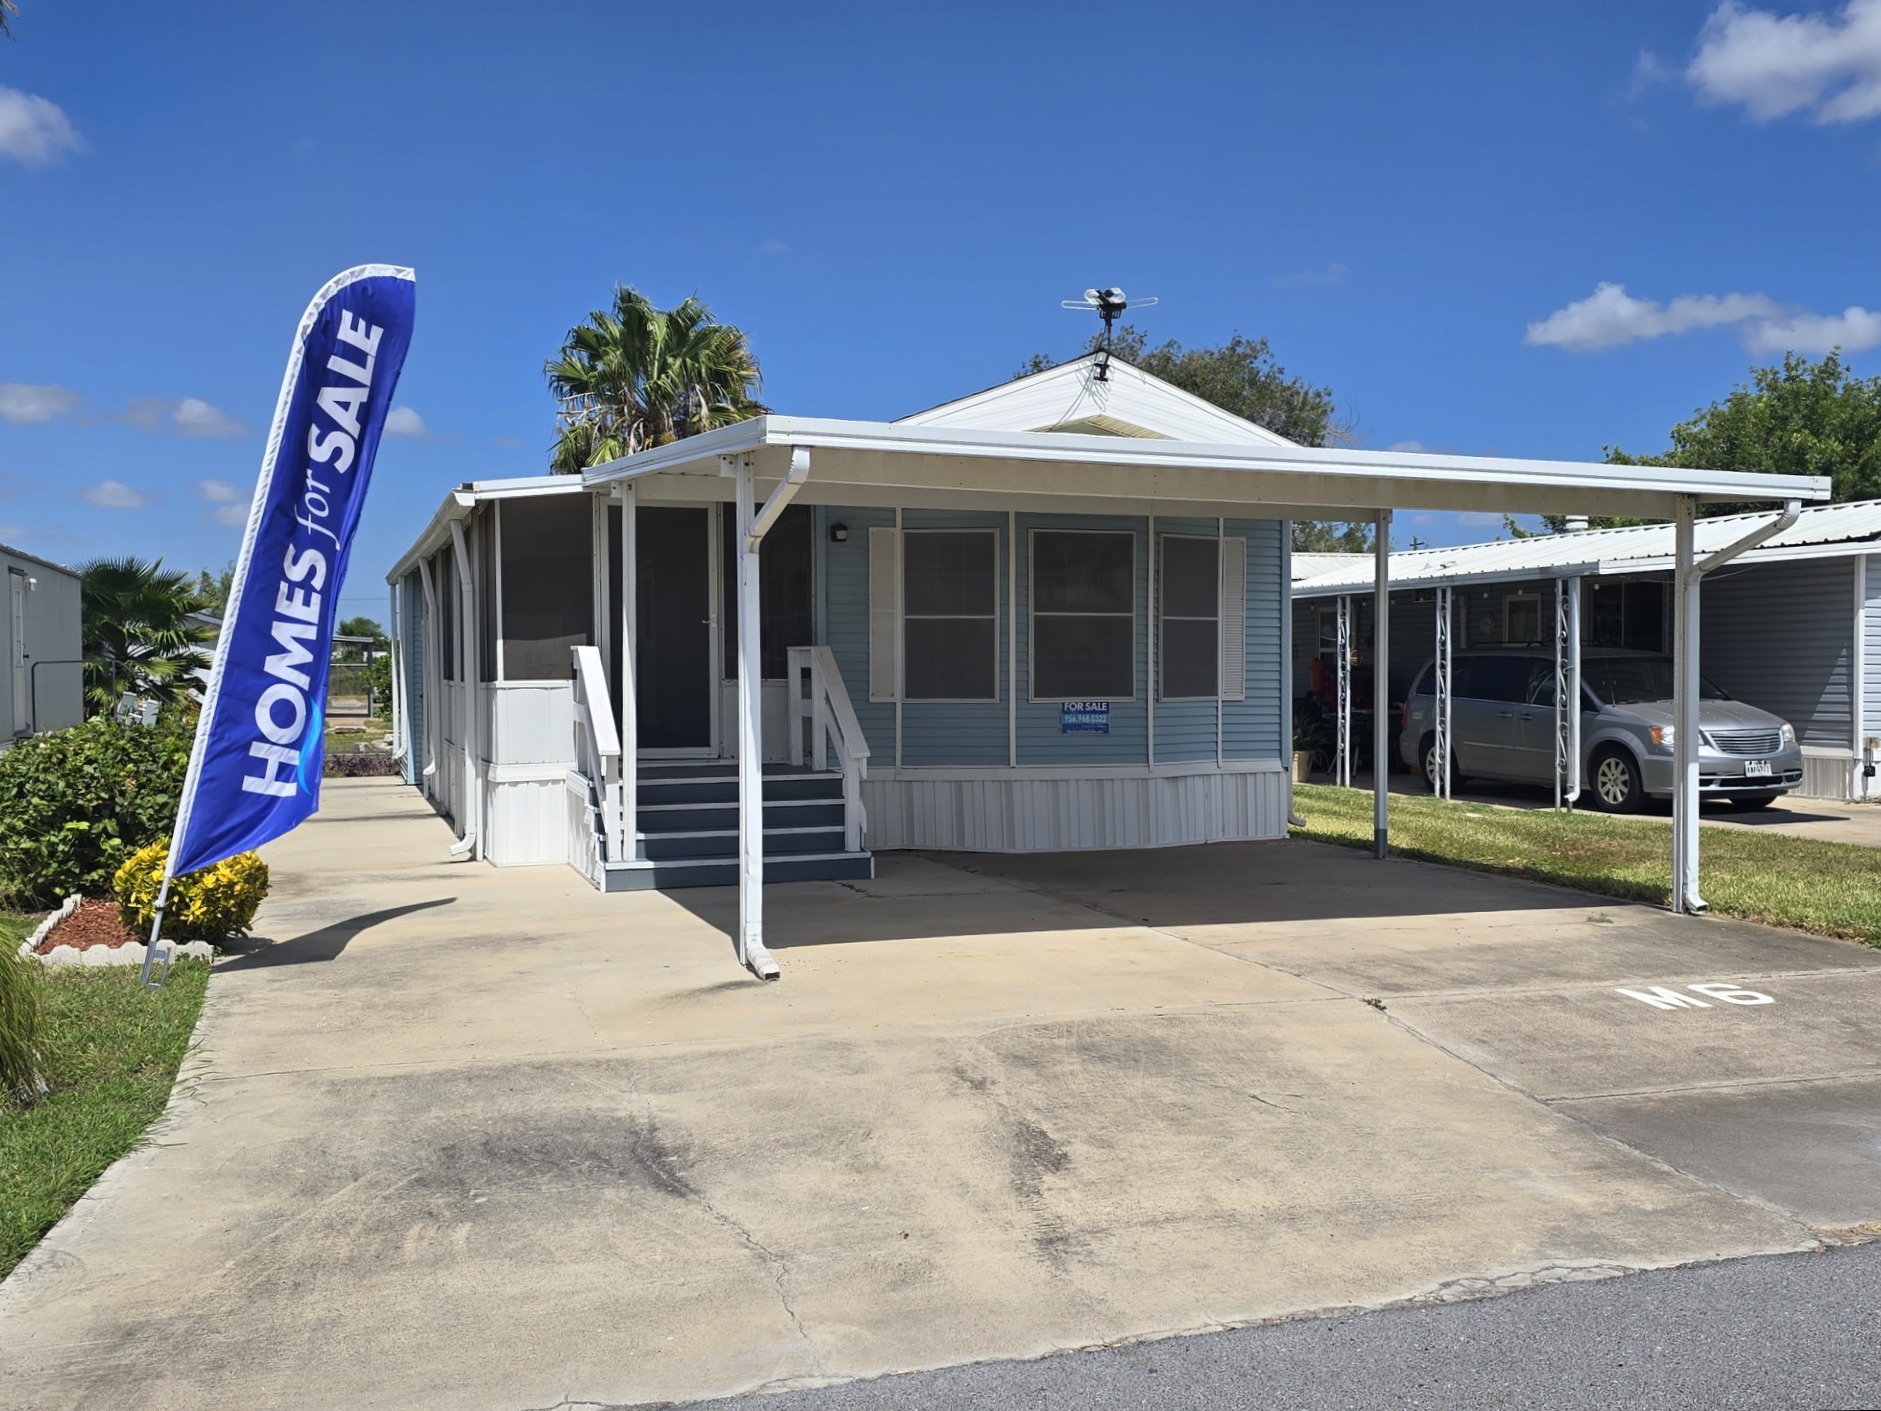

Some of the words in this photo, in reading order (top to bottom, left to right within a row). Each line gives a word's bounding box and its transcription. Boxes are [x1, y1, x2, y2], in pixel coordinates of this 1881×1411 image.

[307, 308, 384, 474] SALE
[294, 468, 340, 551] for
[242, 543, 327, 797] HOMES
[1064, 702, 1083, 711] FOR
[1085, 702, 1107, 711] SALE
